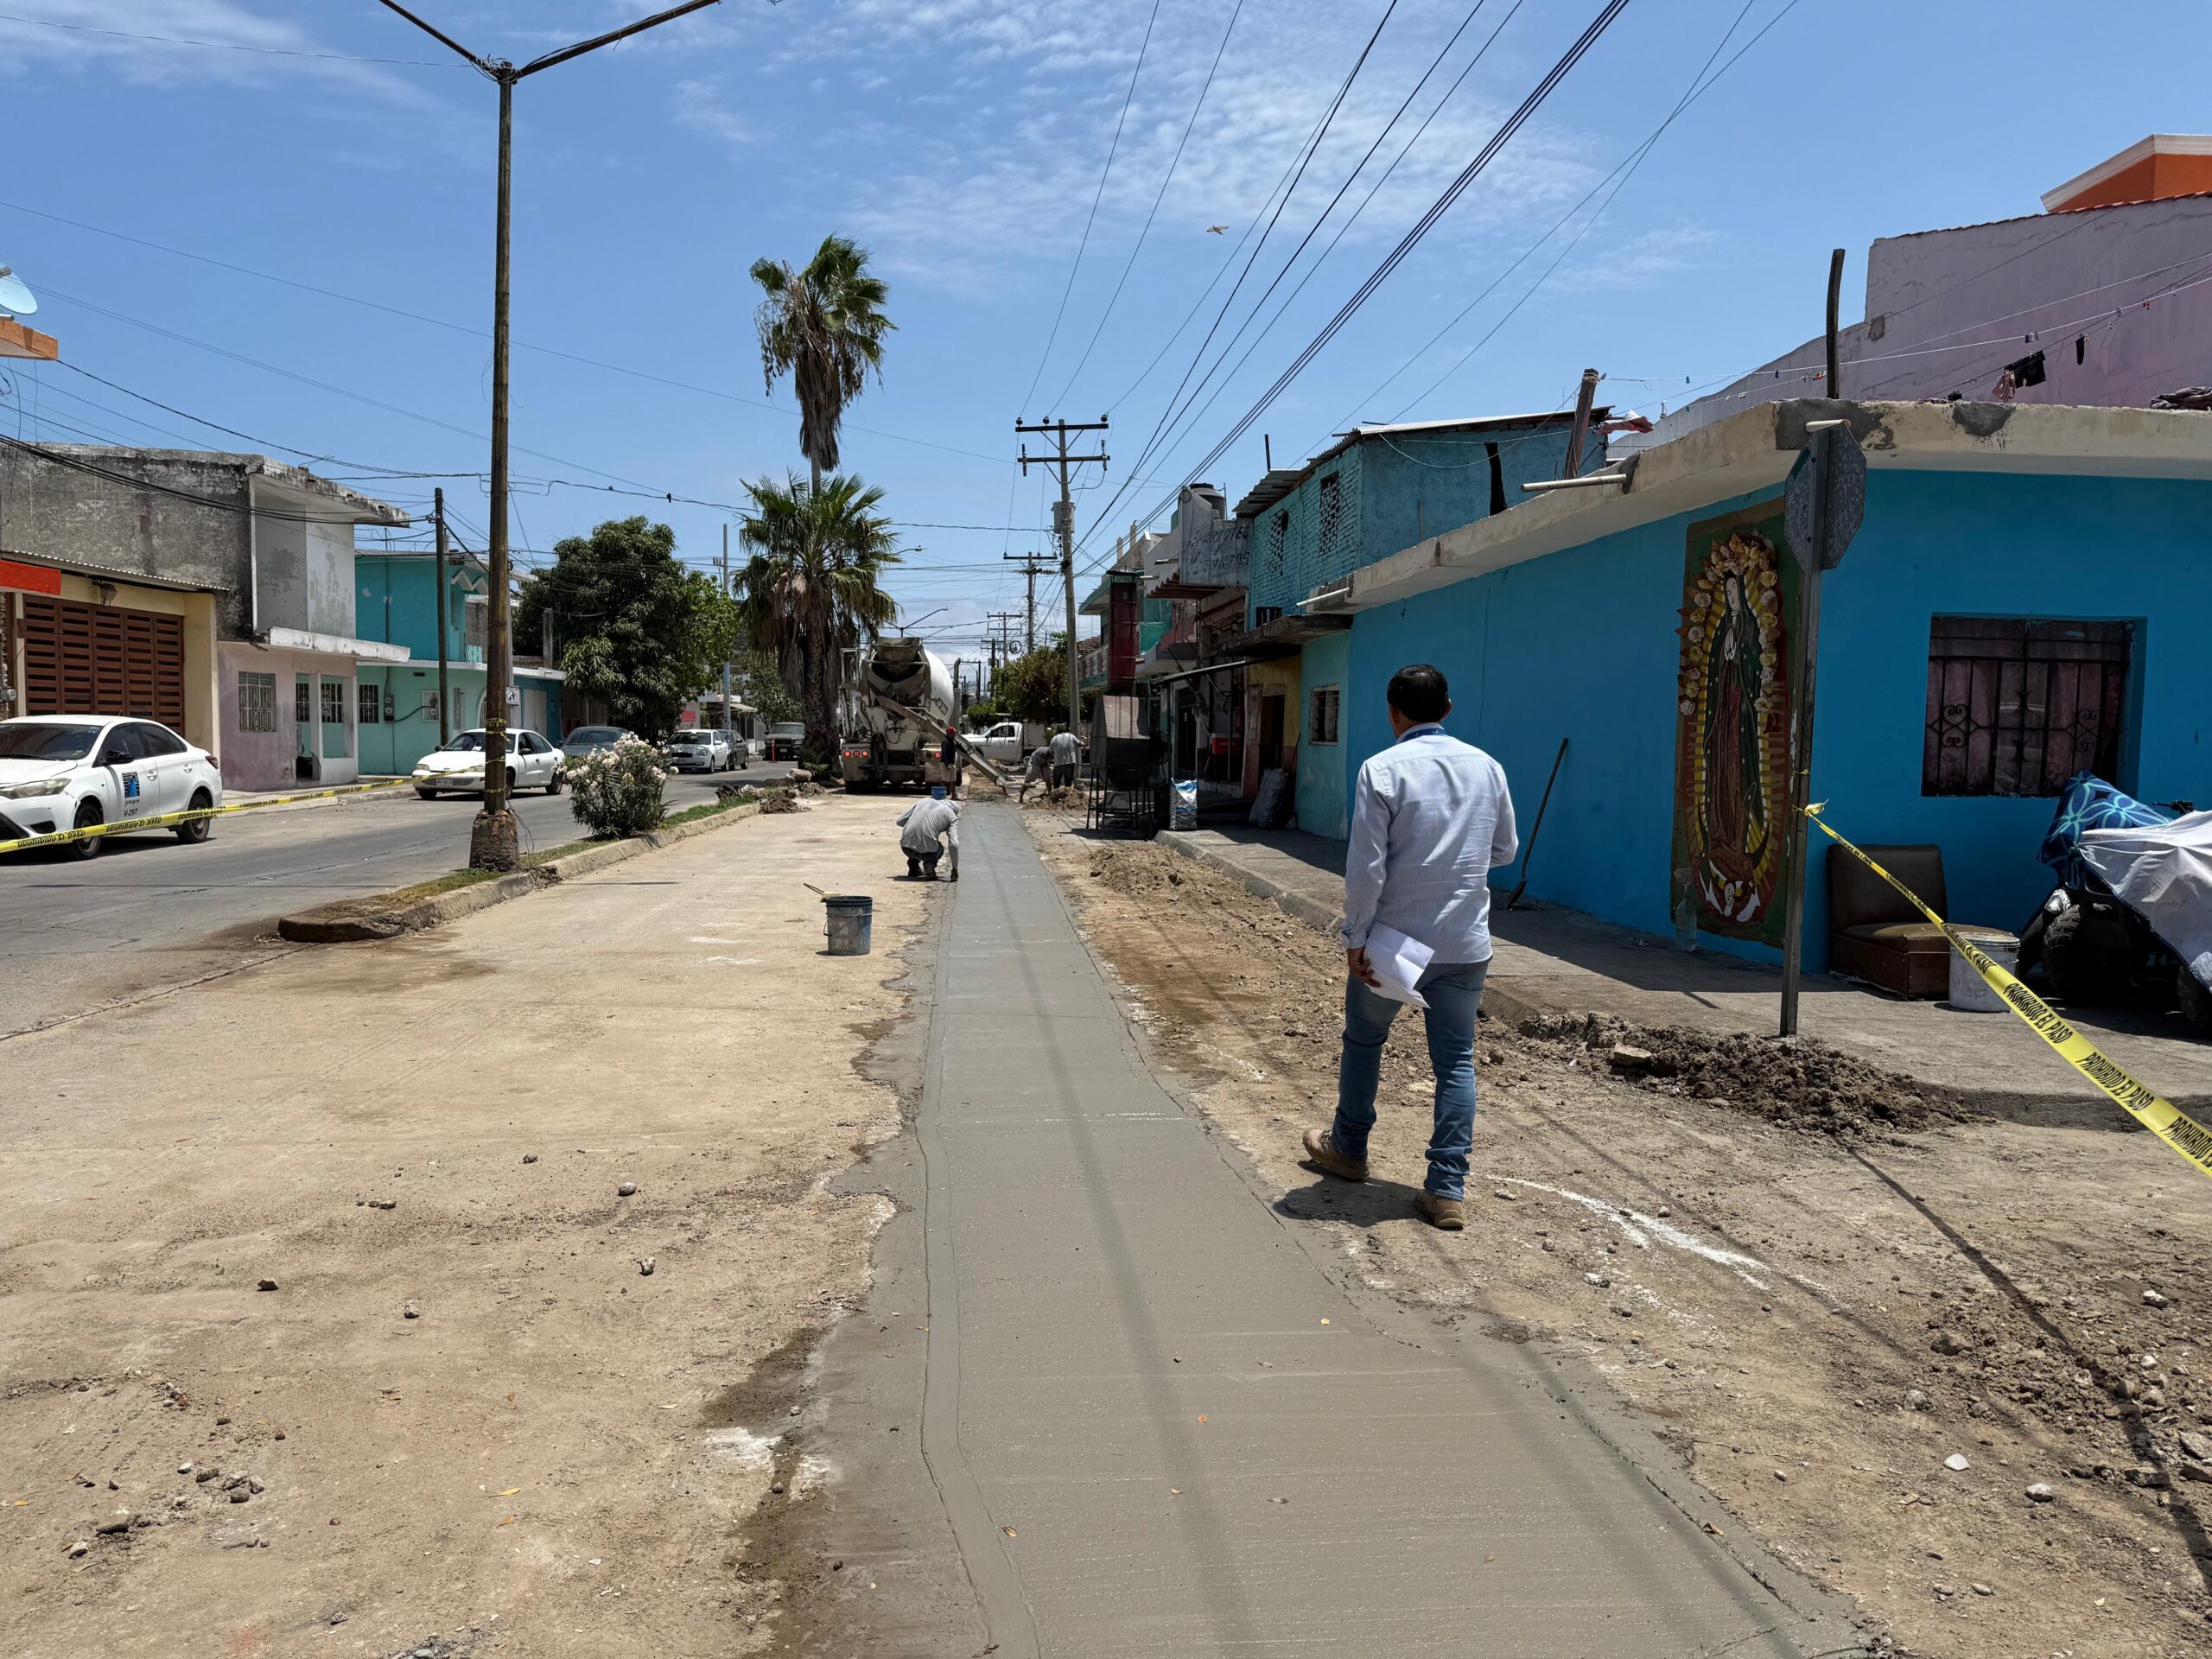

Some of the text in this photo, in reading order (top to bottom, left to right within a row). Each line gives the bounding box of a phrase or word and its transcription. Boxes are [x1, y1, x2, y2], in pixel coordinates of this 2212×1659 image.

[124, 808, 138, 817] V-297
[2003, 982, 2074, 1044] PROHIBIDO EL PASO
[2075, 1052, 2155, 1111] PROHIBIDO EL PASO
[2159, 1116, 2212, 1160] PROHIBIDO
